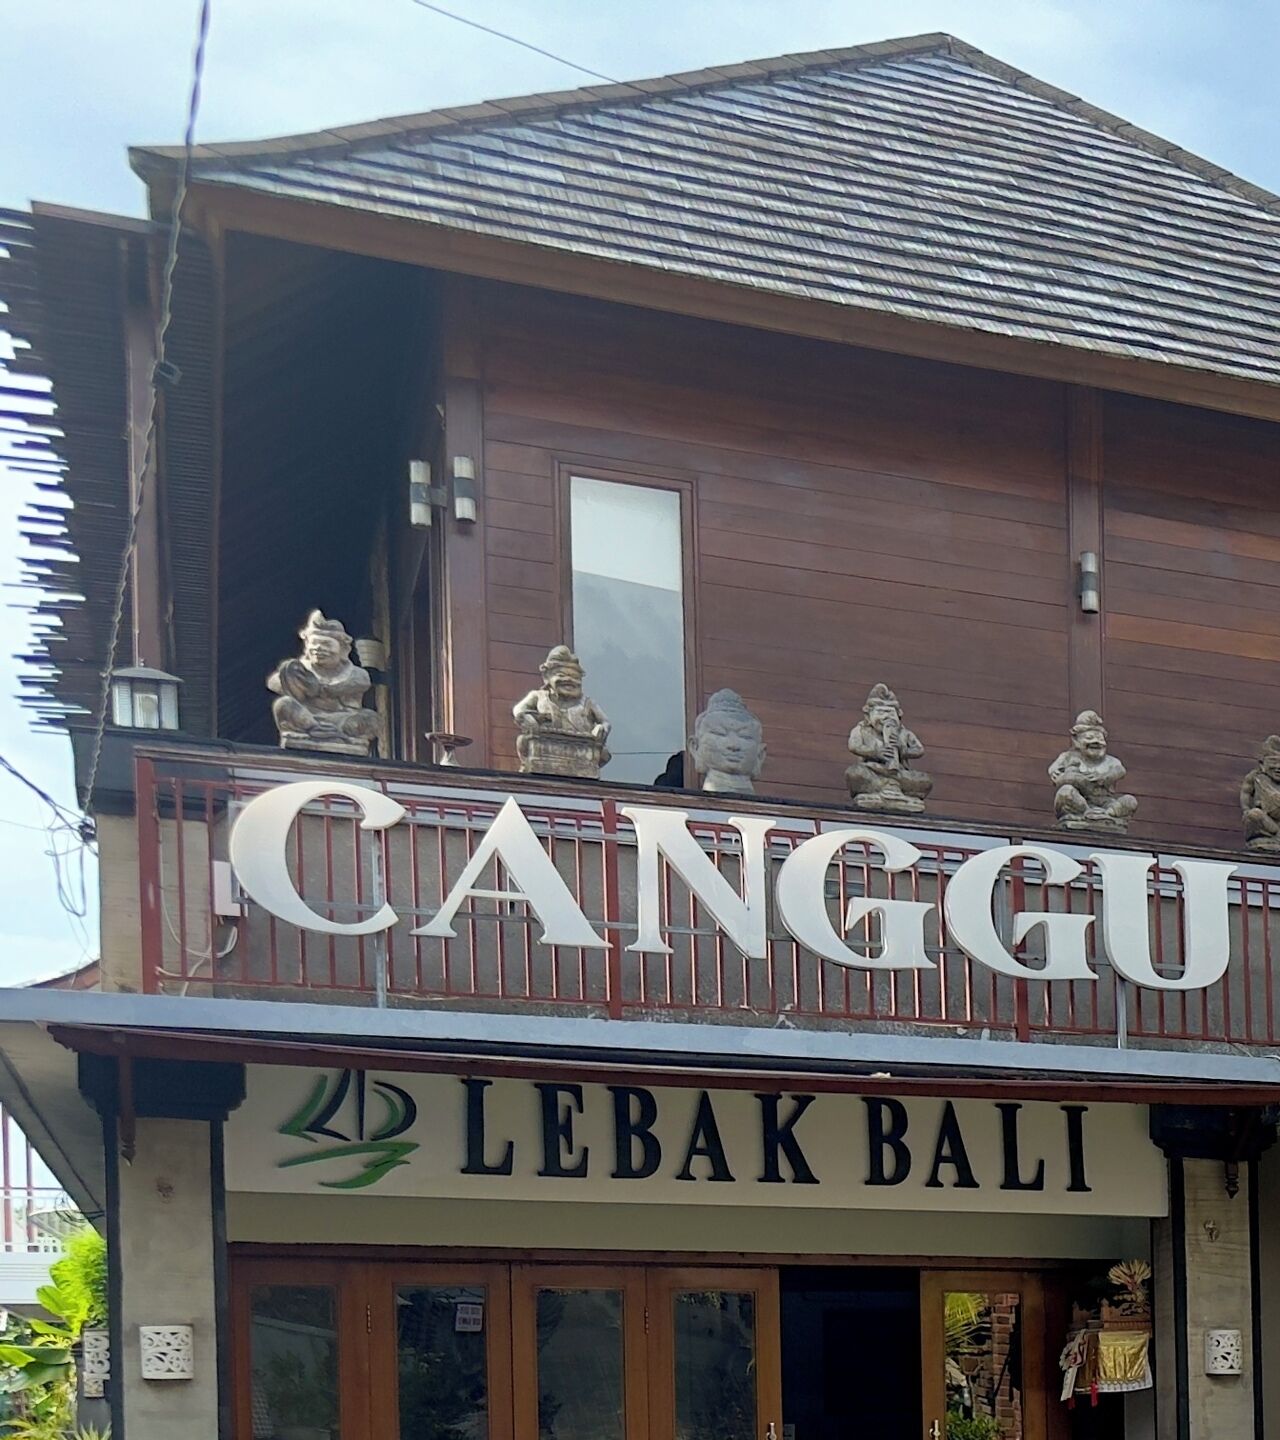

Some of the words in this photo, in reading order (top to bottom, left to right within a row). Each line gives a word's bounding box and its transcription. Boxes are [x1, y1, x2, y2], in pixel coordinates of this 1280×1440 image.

[229, 780, 1238, 991] CANGGU
[460, 1078, 821, 1185] LEBAK
[861, 1095, 1093, 1193] BALI
